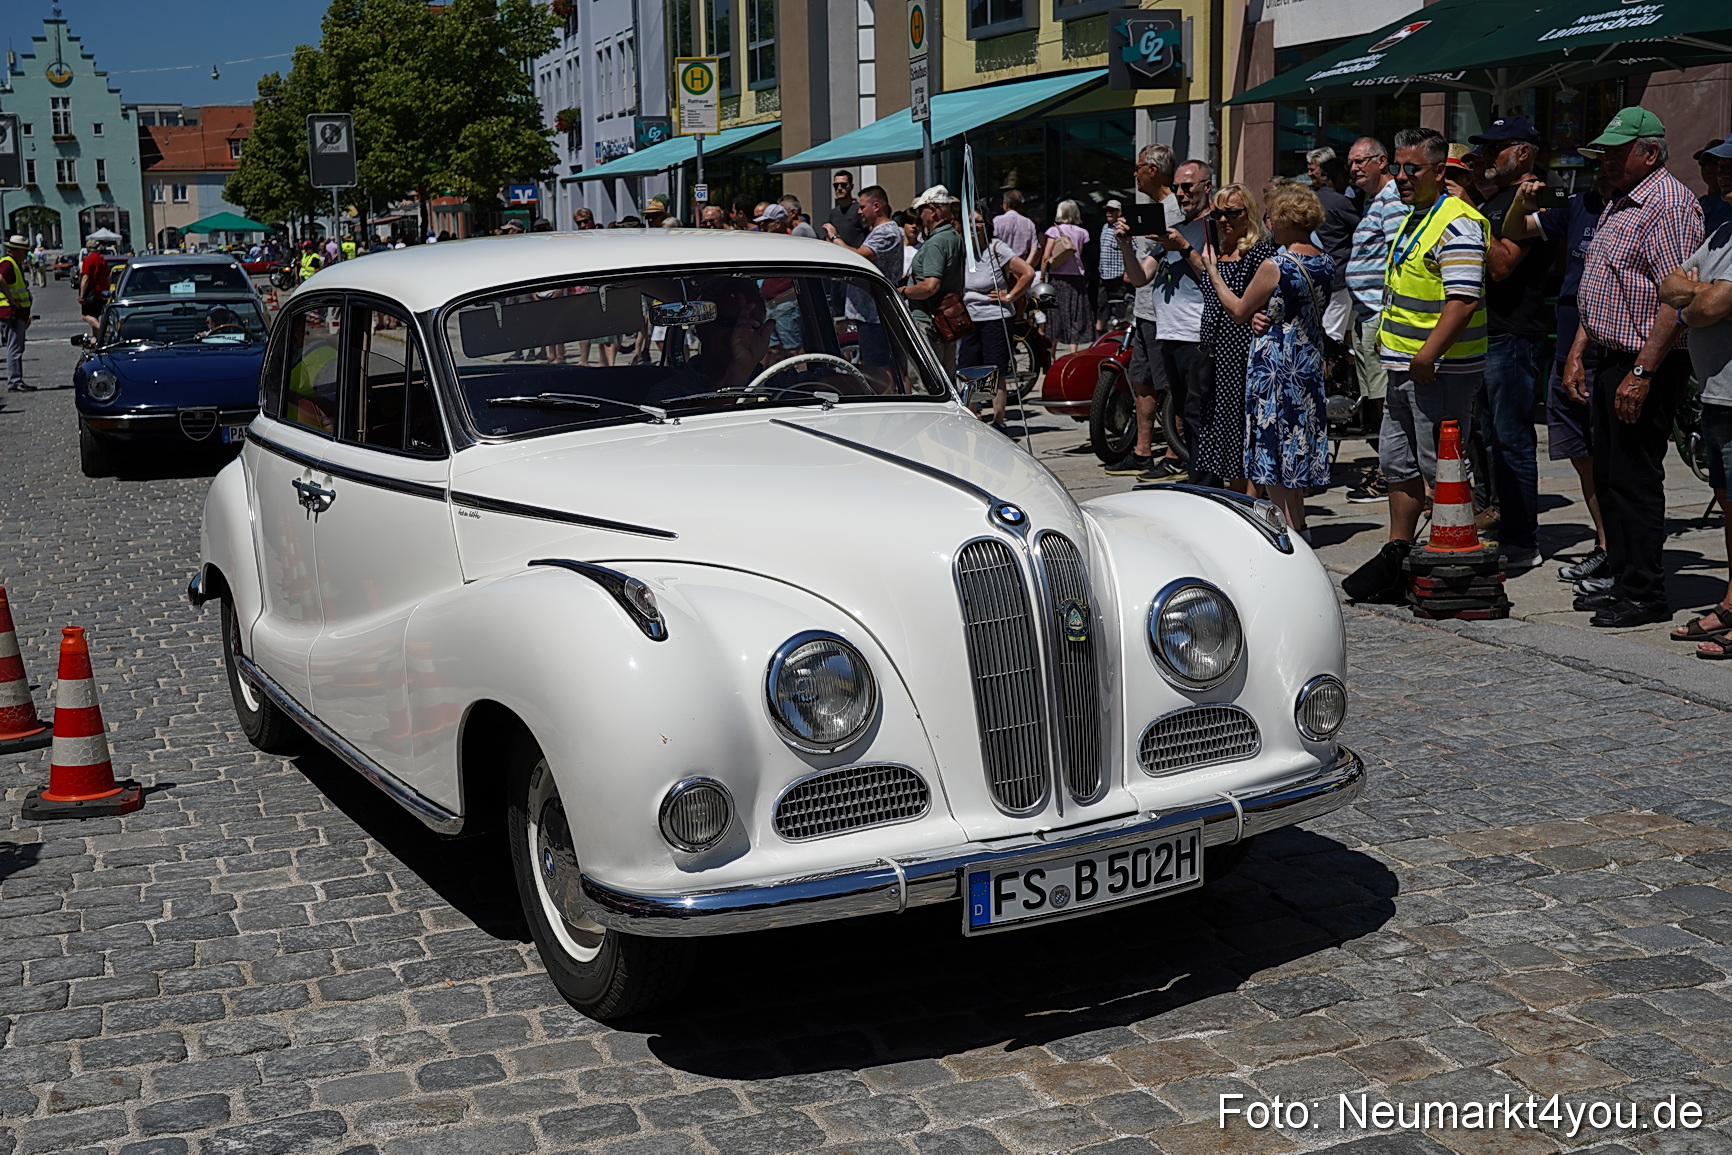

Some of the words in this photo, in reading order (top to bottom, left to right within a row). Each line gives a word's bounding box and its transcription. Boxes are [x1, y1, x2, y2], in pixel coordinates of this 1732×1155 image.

[1572, 4, 1665, 25] Neumarkter
[1537, 13, 1664, 41] Lammsbräu
[1140, 30, 1164, 63] G2
[691, 69, 705, 89] H
[648, 126, 662, 142] G2
[975, 904, 984, 917] D
[993, 868, 1047, 917] FS
[1075, 858, 1099, 902] B
[1107, 835, 1197, 895] 502H
